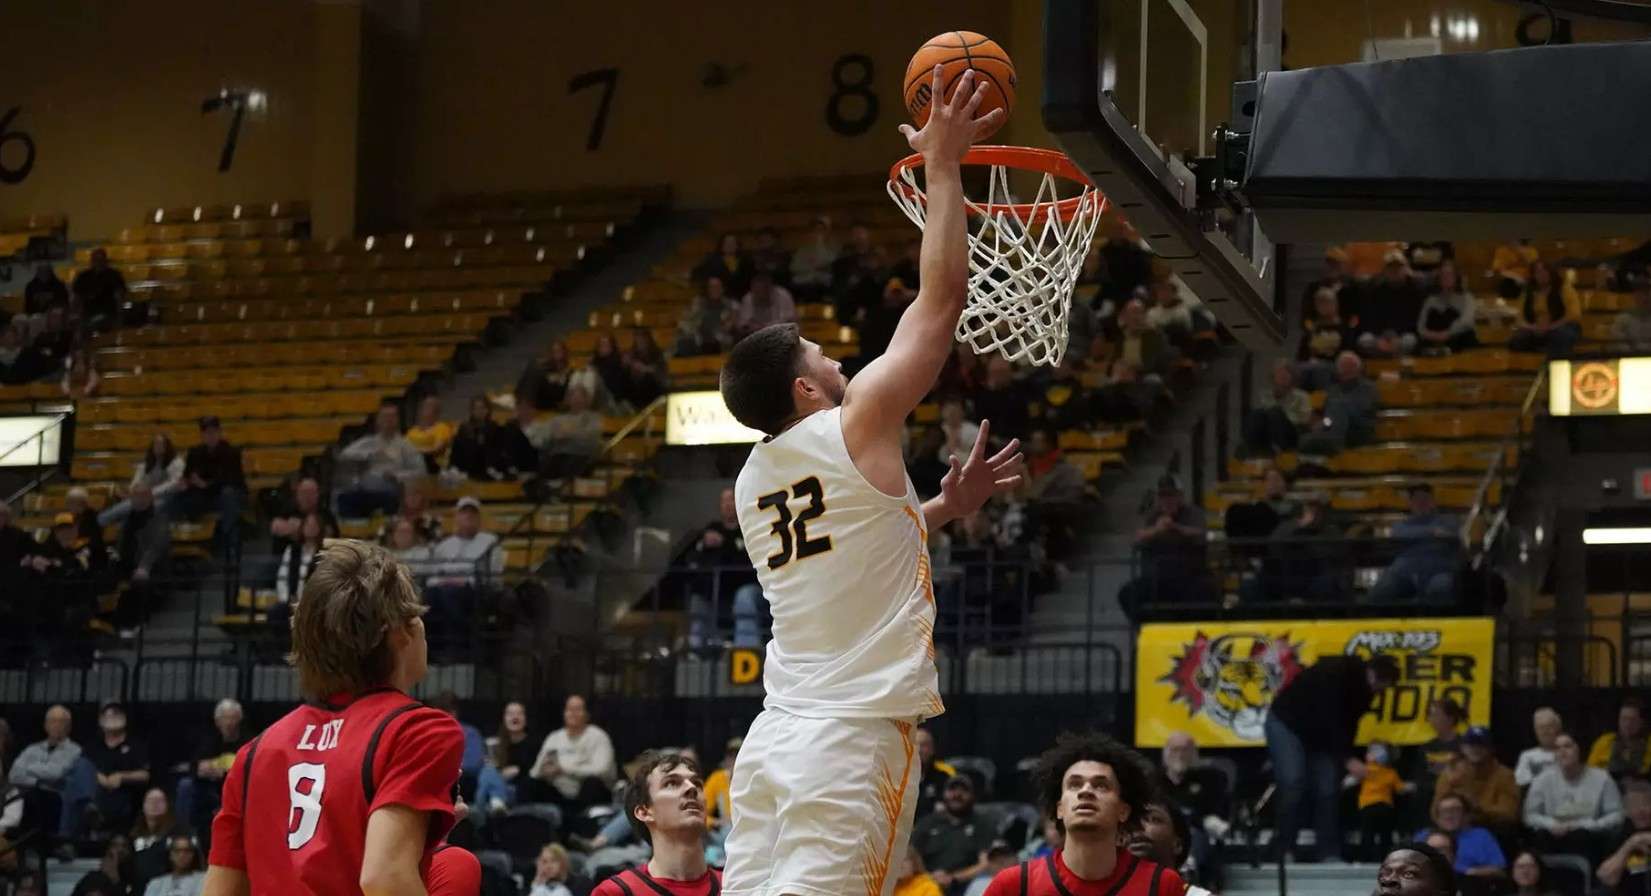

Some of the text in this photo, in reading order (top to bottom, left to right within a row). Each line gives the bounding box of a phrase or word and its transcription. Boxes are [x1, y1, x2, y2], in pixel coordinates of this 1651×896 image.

[202, 89, 247, 173] 7
[568, 66, 619, 151] 7
[825, 52, 882, 137] 8
[0, 103, 36, 184] 6
[757, 475, 832, 571] 32
[731, 648, 760, 685] D
[296, 718, 345, 752] LUX
[287, 760, 326, 851] 8
